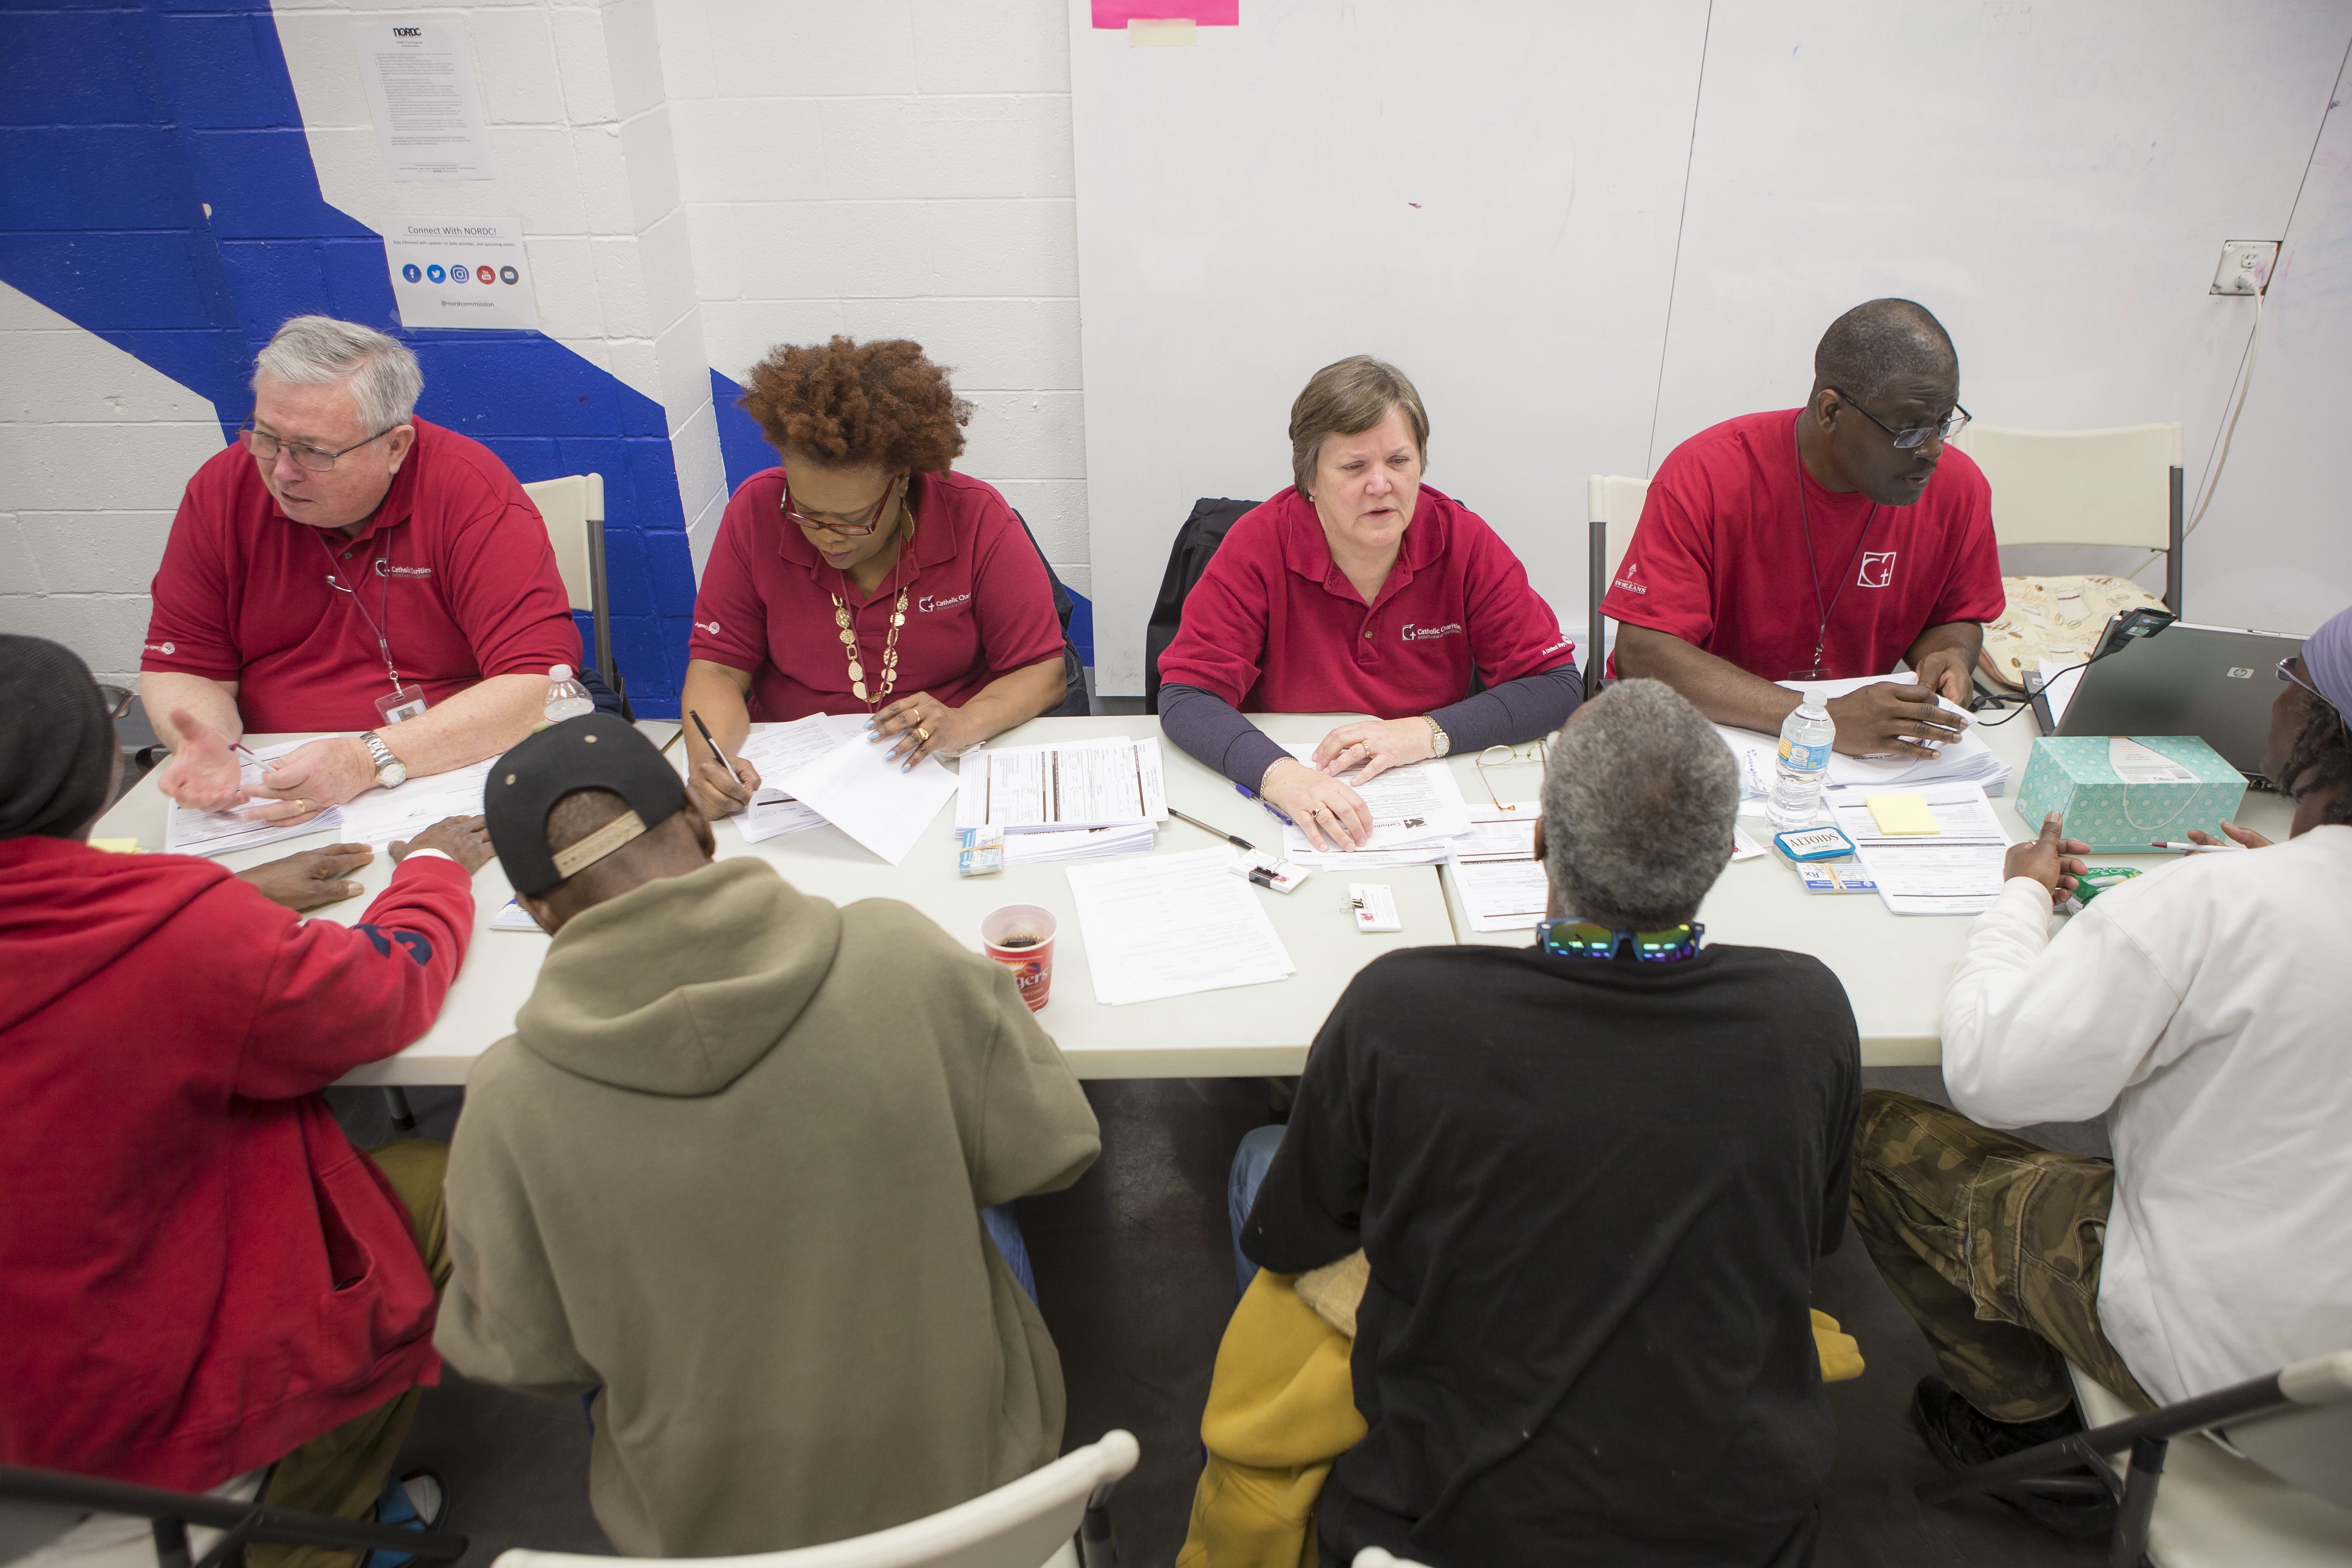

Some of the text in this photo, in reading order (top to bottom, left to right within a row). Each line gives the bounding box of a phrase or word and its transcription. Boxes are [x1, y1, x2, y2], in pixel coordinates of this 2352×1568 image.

[408, 226, 441, 235] Connect
[442, 226, 462, 235] With
[1621, 581, 1646, 593] ORLEANS
[936, 597, 959, 607] Catholic
[1545, 644, 1558, 653] United
[1790, 833, 1839, 847] ALTOIDS
